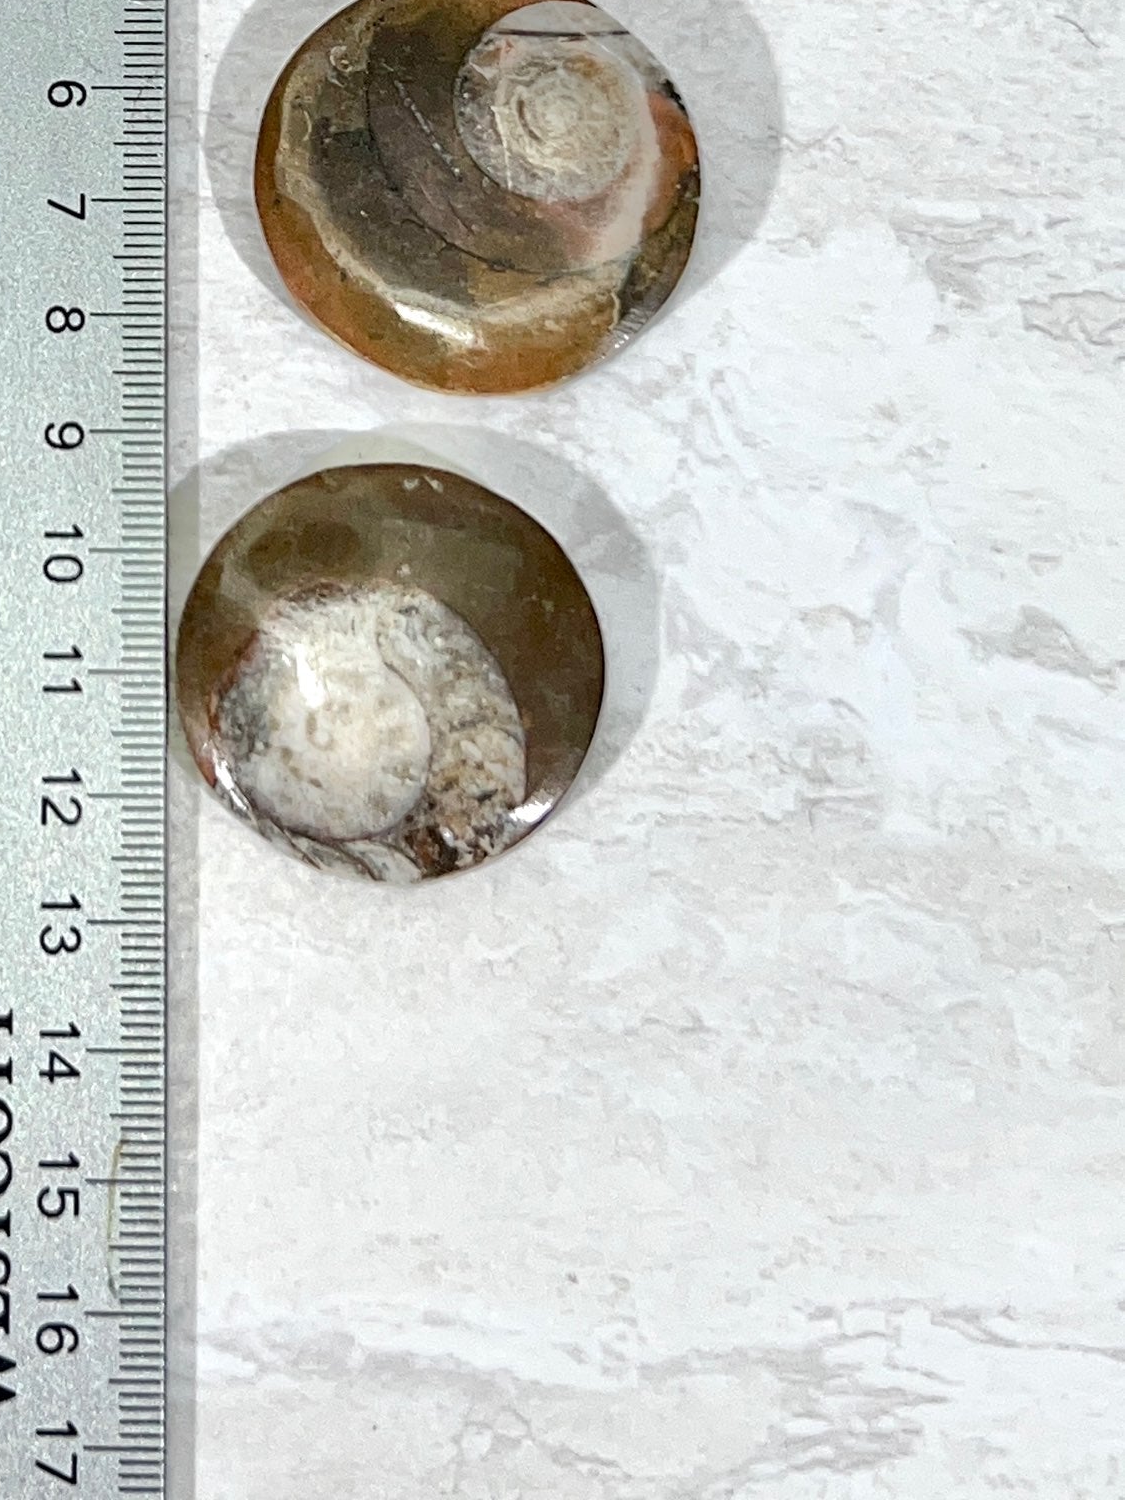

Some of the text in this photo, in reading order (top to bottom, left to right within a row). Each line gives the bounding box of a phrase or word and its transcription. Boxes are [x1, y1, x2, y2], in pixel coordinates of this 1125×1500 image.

[47, 80, 87, 108] 6
[47, 193, 86, 221] 7
[45, 305, 86, 334] 8
[44, 421, 85, 450] 9
[43, 524, 84, 584] 10
[42, 646, 83, 693] 11
[41, 769, 82, 826] 12
[39, 894, 82, 956] 13
[38, 1022, 81, 1084] 14
[37, 1152, 80, 1219] 15
[35, 1285, 80, 1356] 16
[34, 1420, 79, 1486] 17
